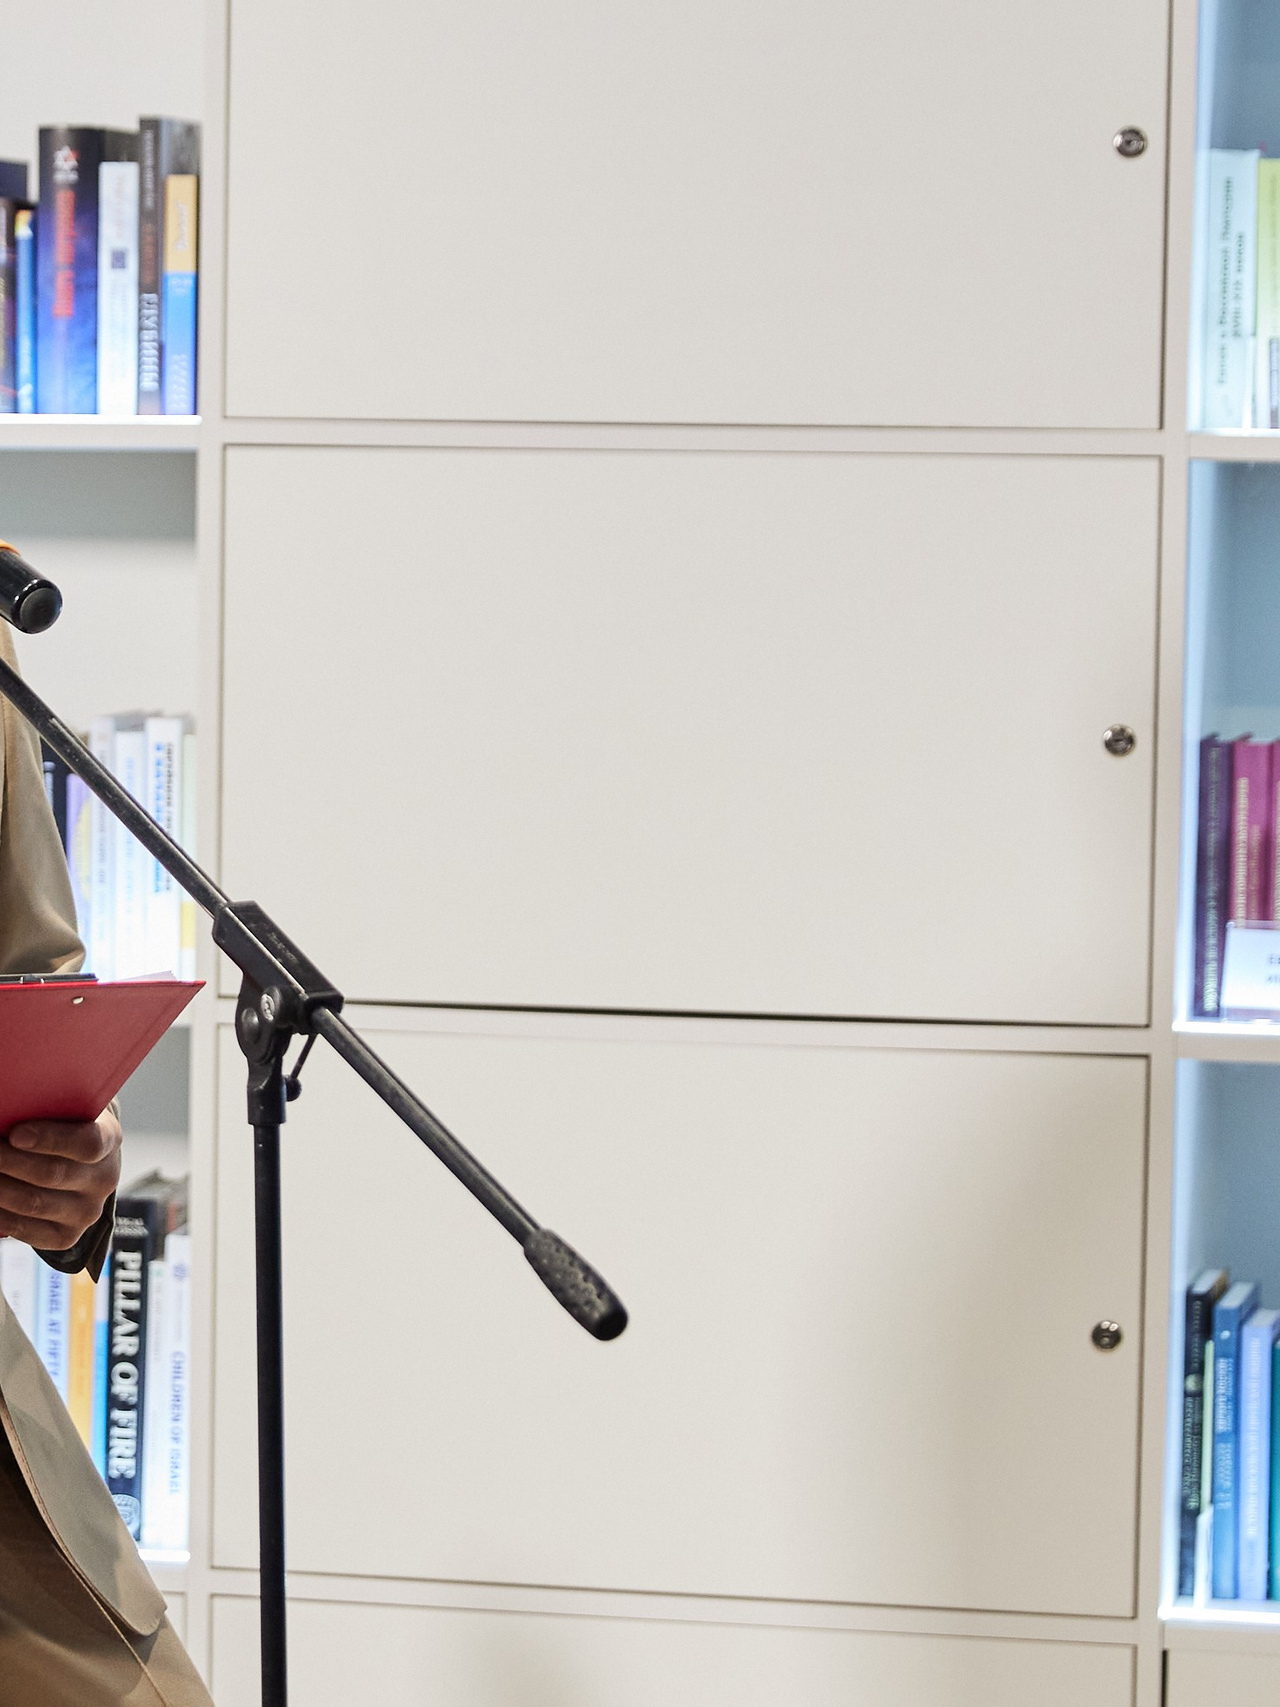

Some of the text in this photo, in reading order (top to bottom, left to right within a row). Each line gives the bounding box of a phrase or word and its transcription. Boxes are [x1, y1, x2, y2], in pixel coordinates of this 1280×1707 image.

[140, 293, 159, 391] ГЛУБИНЫ
[49, 1319, 61, 1334] AT
[111, 1250, 143, 1356] PILLAR
[109, 1360, 140, 1403] OF
[170, 1351, 186, 1422] CHILDREN
[108, 1407, 138, 1480] FIRE
[170, 1426, 184, 1444] OF
